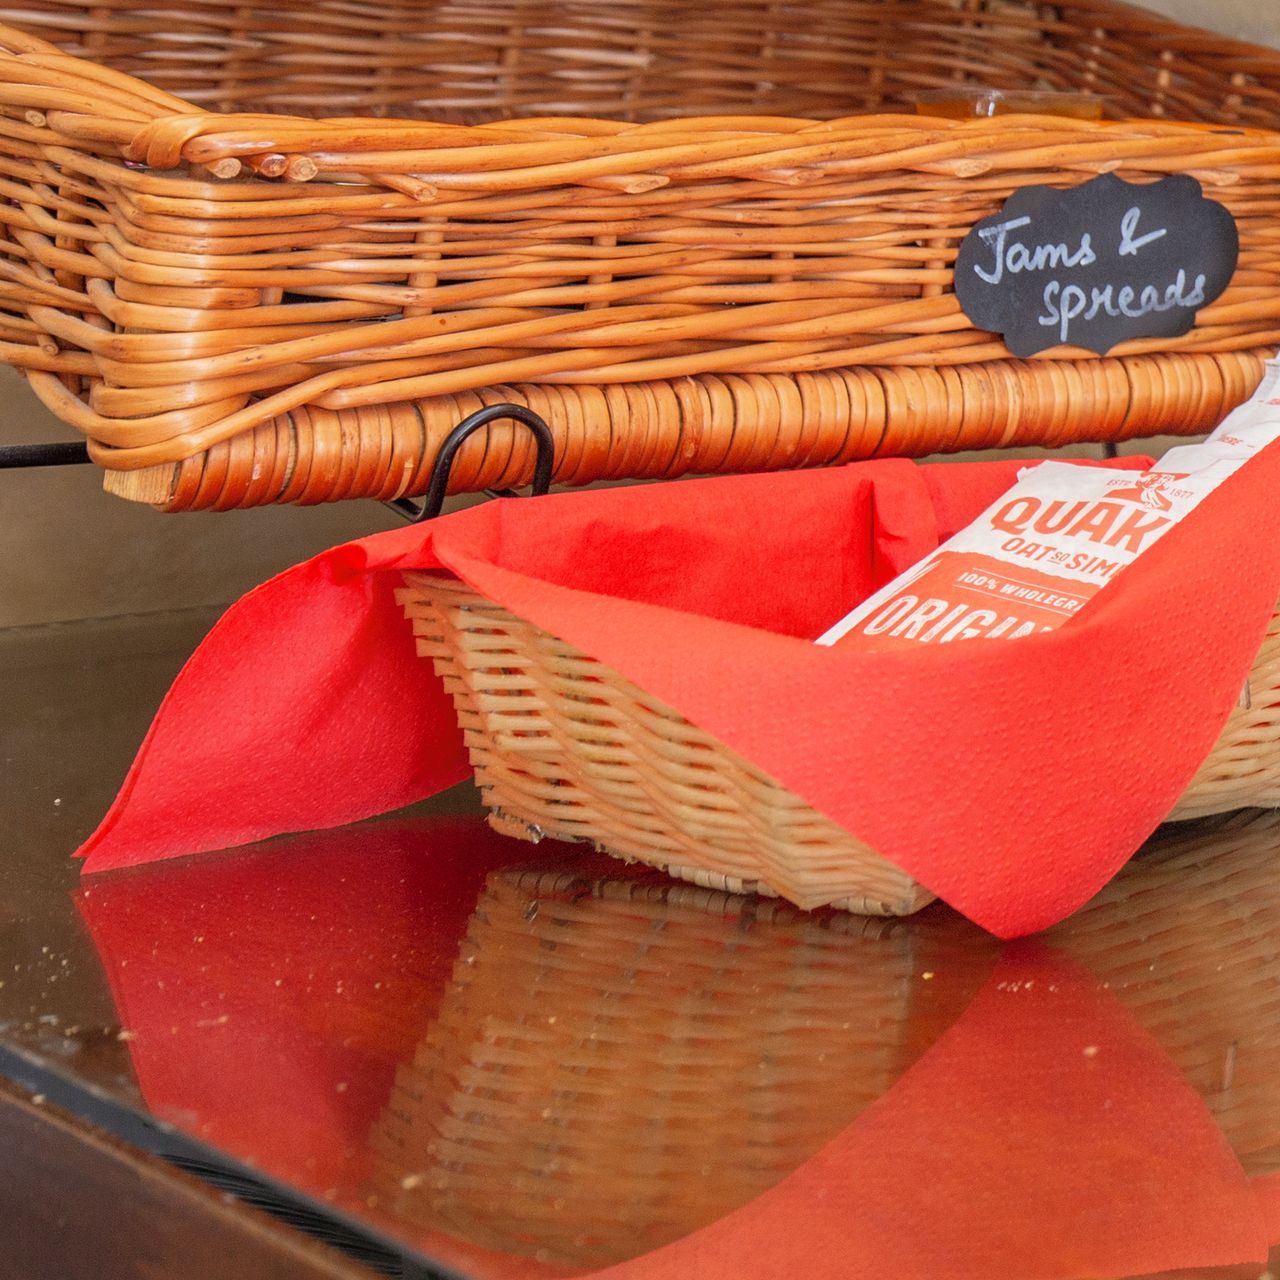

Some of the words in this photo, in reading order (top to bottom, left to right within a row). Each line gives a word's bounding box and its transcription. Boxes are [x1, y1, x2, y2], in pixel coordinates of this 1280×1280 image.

[974, 216, 1096, 285] Jams
[1119, 207, 1167, 256] &
[1169, 488, 1194, 499] 1877
[1001, 538, 1057, 561] OAT
[957, 572, 996, 590] 100%
